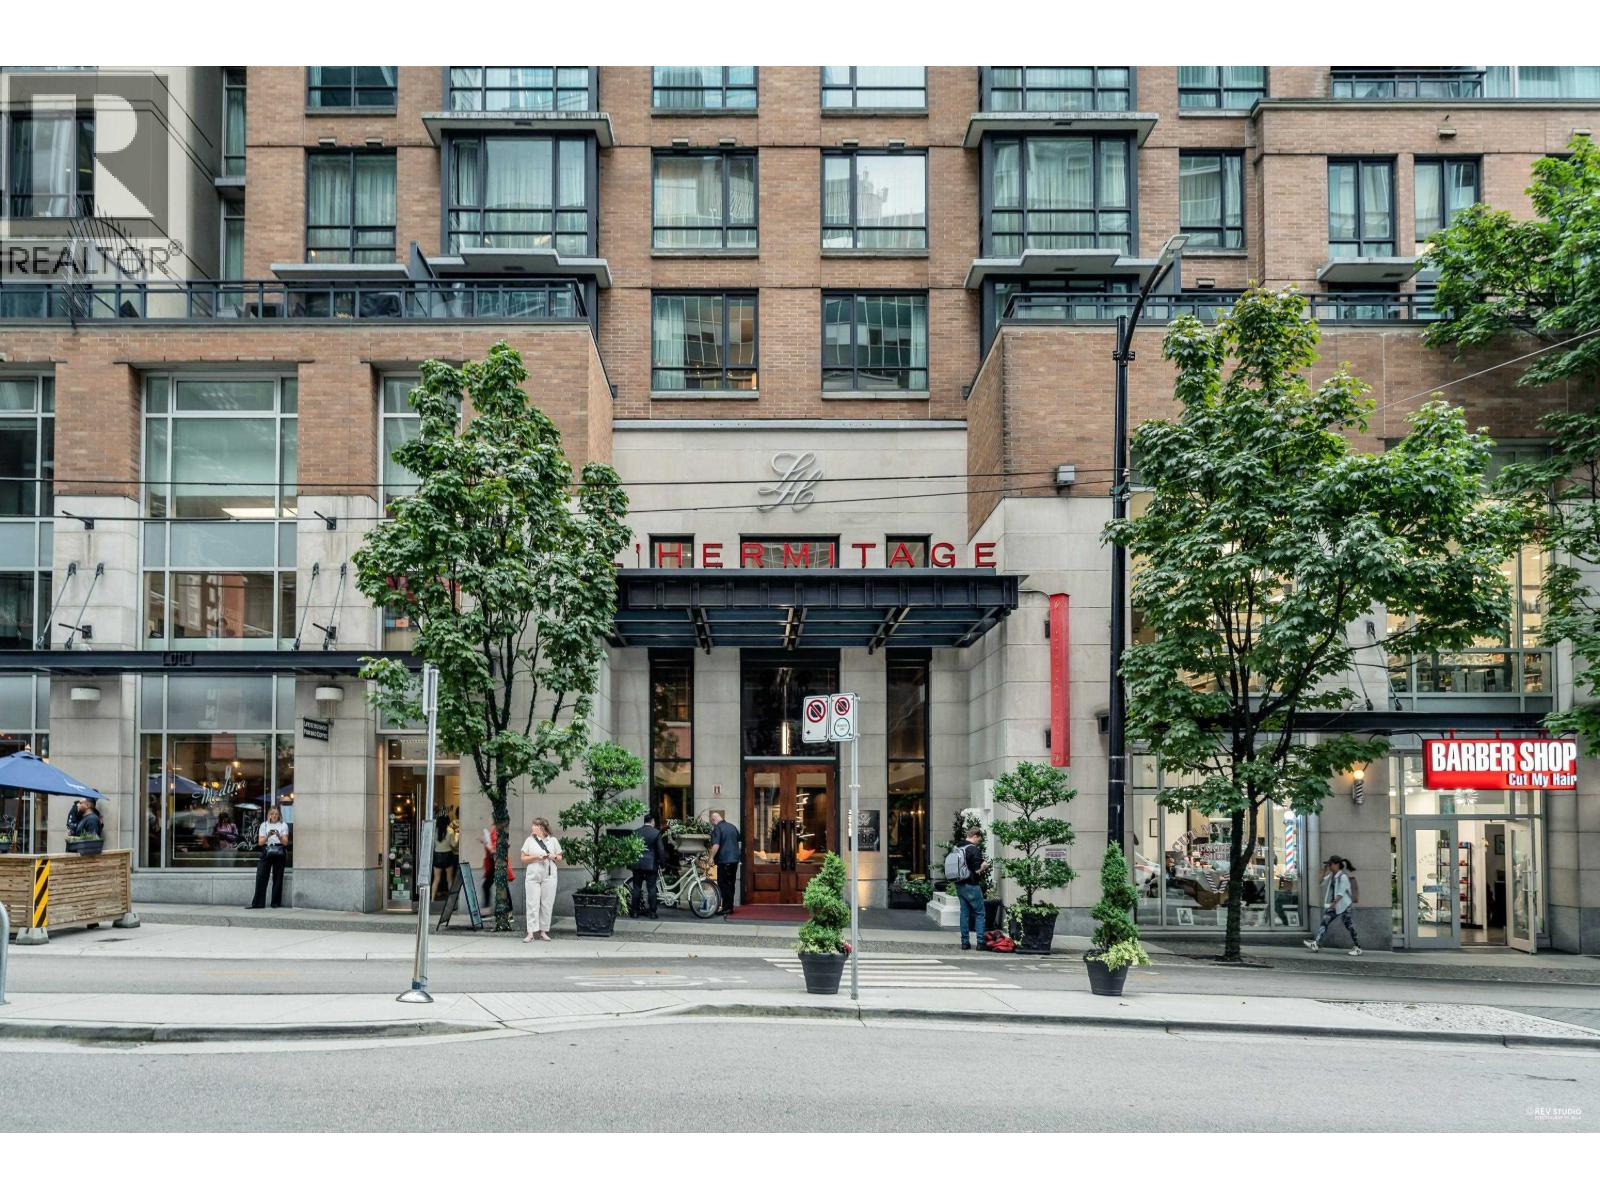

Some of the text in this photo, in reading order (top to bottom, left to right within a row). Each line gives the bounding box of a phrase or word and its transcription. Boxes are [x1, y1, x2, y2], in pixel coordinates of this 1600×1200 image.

[611, 542, 997, 568] 'HERMITAGE
[1431, 742, 1577, 772] BARBER SHOP
[1508, 773, 1577, 788] Cut My Hair
